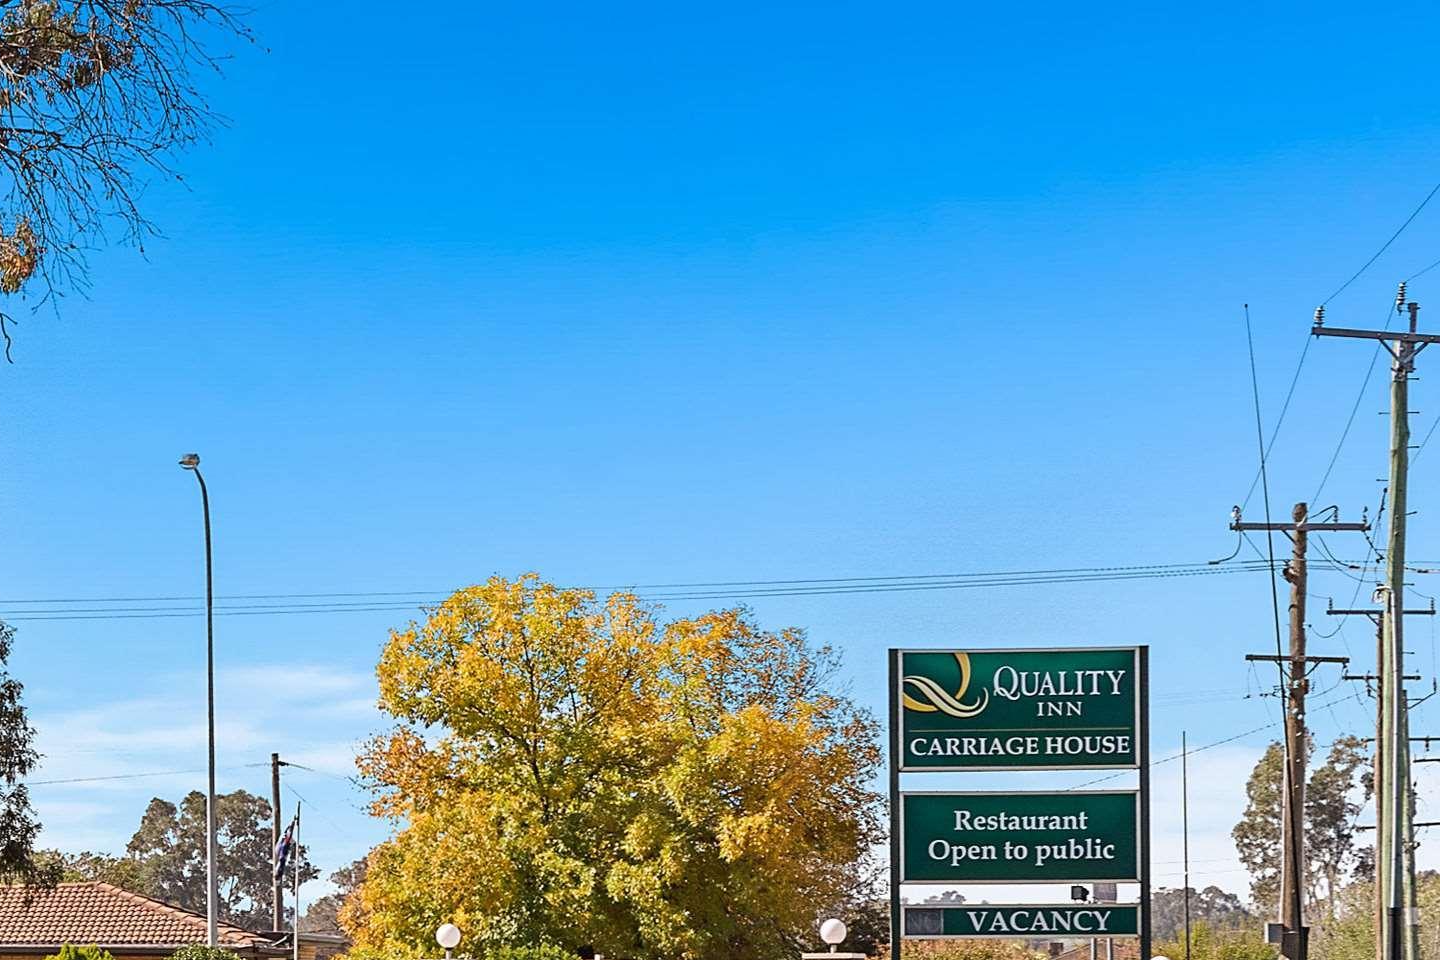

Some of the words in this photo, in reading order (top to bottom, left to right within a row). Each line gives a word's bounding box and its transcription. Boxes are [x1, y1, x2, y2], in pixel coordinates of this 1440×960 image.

[993, 665, 1126, 700] QUALITY
[1037, 702, 1083, 716] INN
[910, 737, 1039, 756] CARRIAGE
[1045, 735, 1130, 754] HOUSE
[954, 810, 1088, 831] Restaurant
[928, 840, 997, 866] Open
[1004, 842, 1028, 860] to
[1035, 838, 1115, 866] public
[967, 911, 1111, 932] VACANCY
